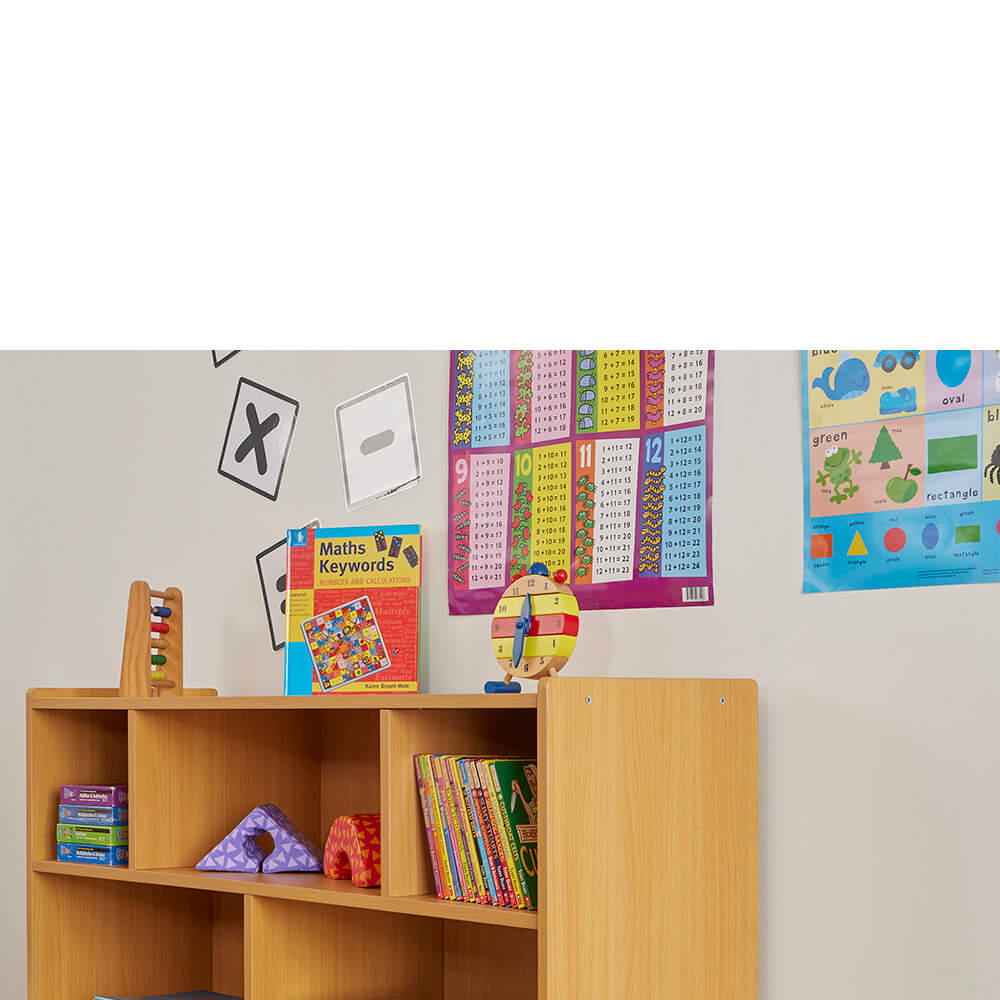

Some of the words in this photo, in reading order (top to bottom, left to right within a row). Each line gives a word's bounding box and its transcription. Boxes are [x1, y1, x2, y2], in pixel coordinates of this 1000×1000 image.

[942, 394, 965, 406] oval
[812, 431, 848, 447] green
[580, 443, 592, 468] 11
[645, 437, 662, 463] 12
[455, 458, 468, 484] 9
[516, 453, 532, 476] 10
[926, 488, 979, 502] rectangle
[319, 541, 366, 556] Maths
[319, 557, 394, 576] Keywords
[366, 577, 411, 585] CALCULATIONS
[498, 605, 507, 613] 10
